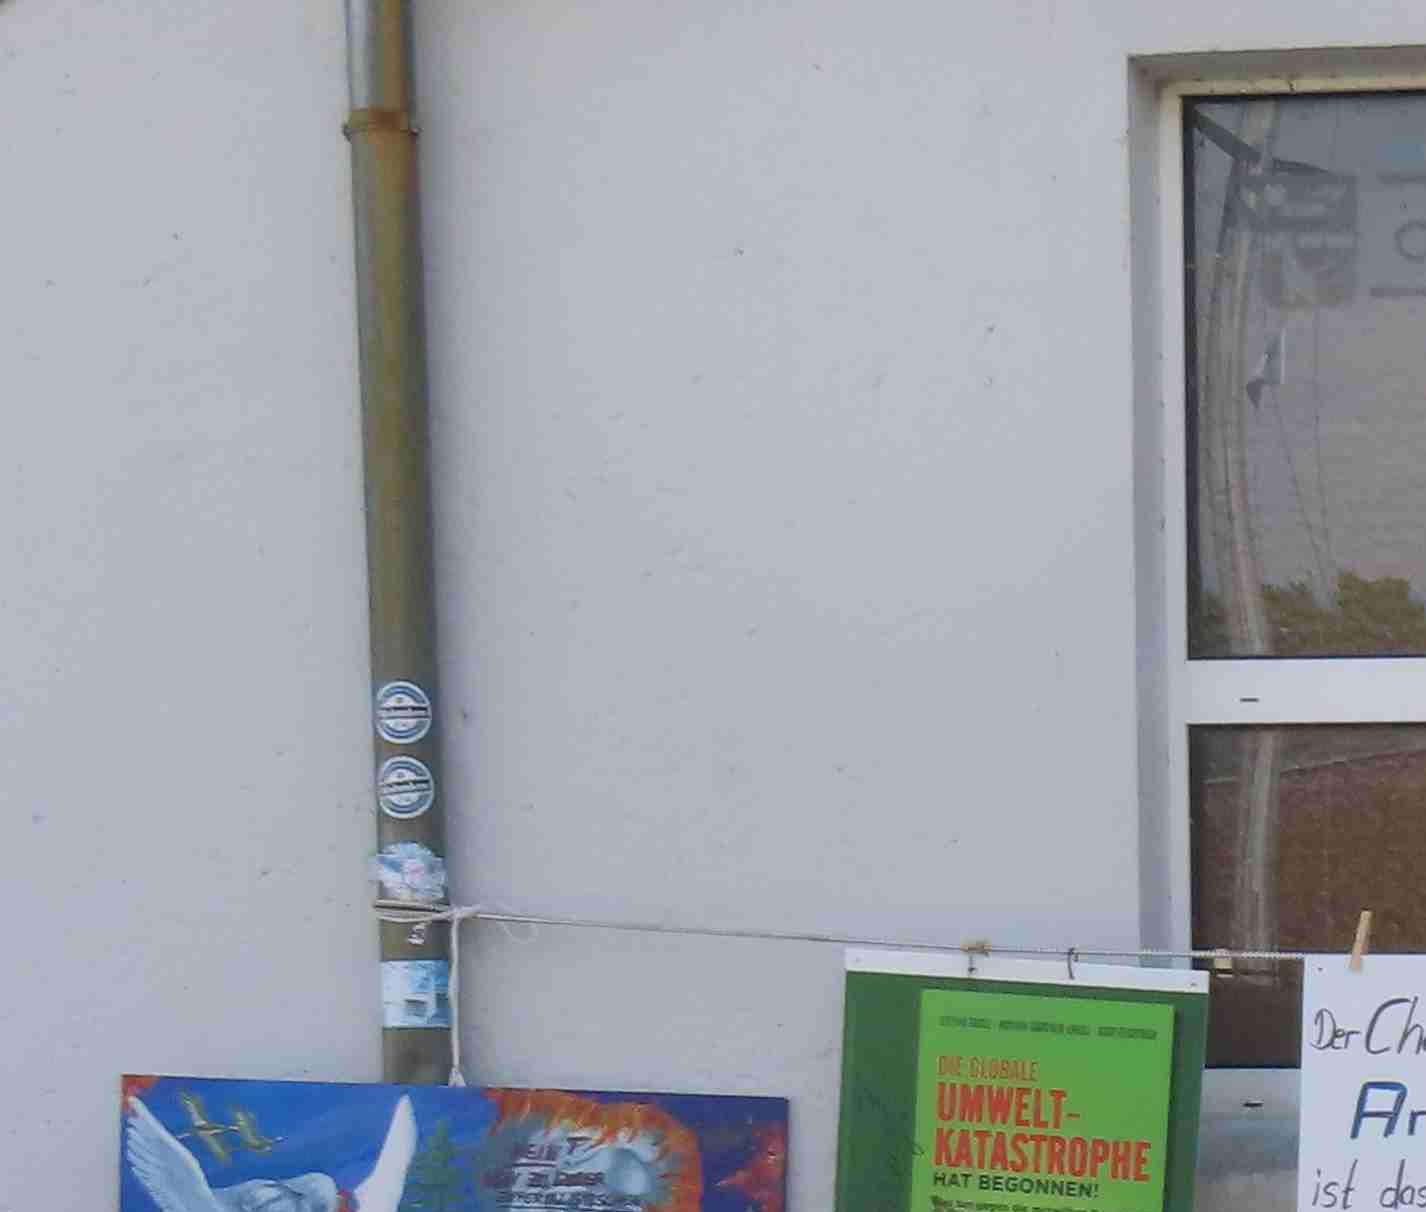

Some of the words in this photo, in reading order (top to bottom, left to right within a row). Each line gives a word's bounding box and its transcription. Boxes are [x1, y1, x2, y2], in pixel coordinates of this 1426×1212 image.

[1309, 1007, 1361, 1053] Der
[937, 1055, 962, 1077] DIE
[969, 1056, 1039, 1082] GLOBALE
[936, 1081, 1081, 1129] UMWELT-
[933, 1127, 1152, 1183] KATASTROPHE
[932, 1172, 972, 1188] HAT
[978, 1174, 1099, 1199] BEGONNEN!
[1311, 1158, 1359, 1209] ist
